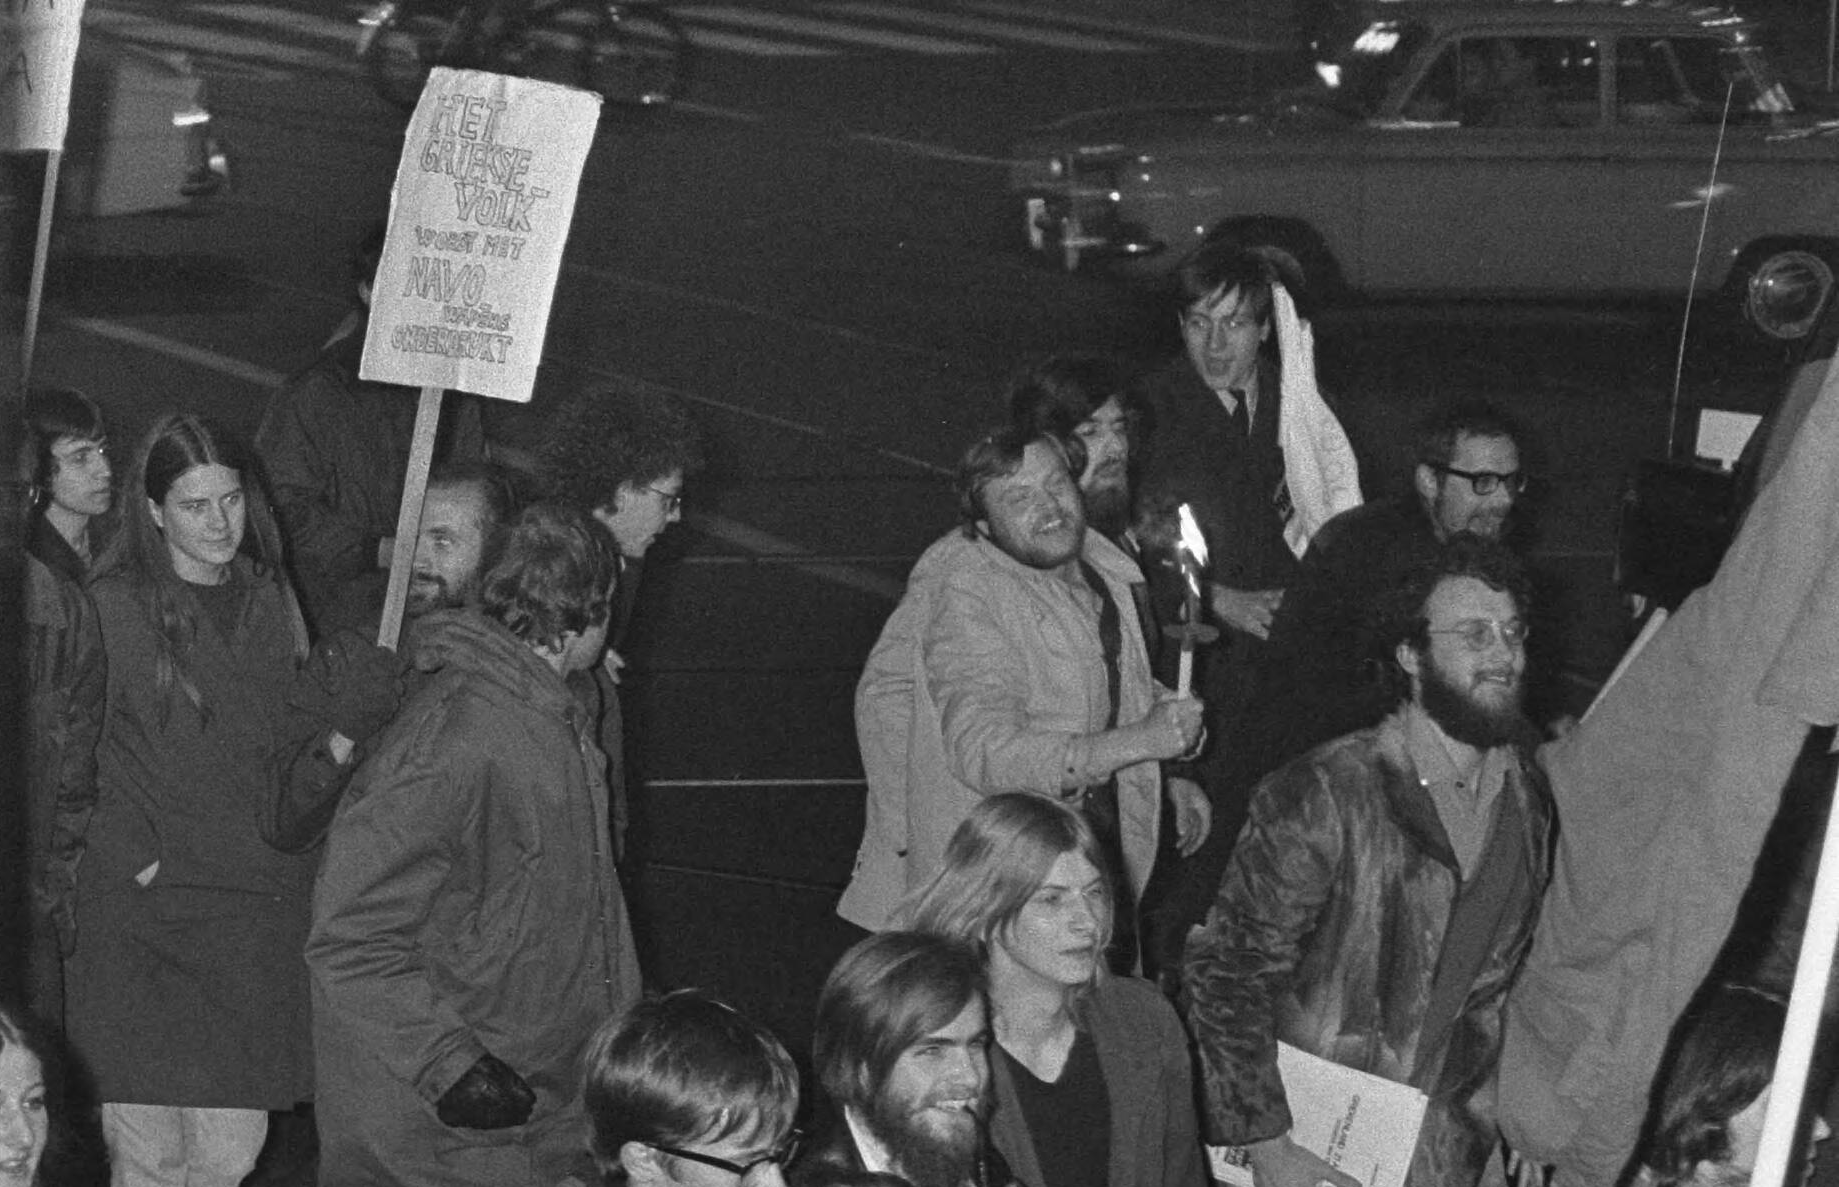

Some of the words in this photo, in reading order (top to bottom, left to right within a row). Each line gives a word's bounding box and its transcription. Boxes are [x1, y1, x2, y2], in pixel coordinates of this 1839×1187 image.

[429, 94, 507, 143] HET
[420, 138, 533, 191] GRIEKSE
[454, 182, 551, 232] VOLK
[481, 234, 527, 260] MET
